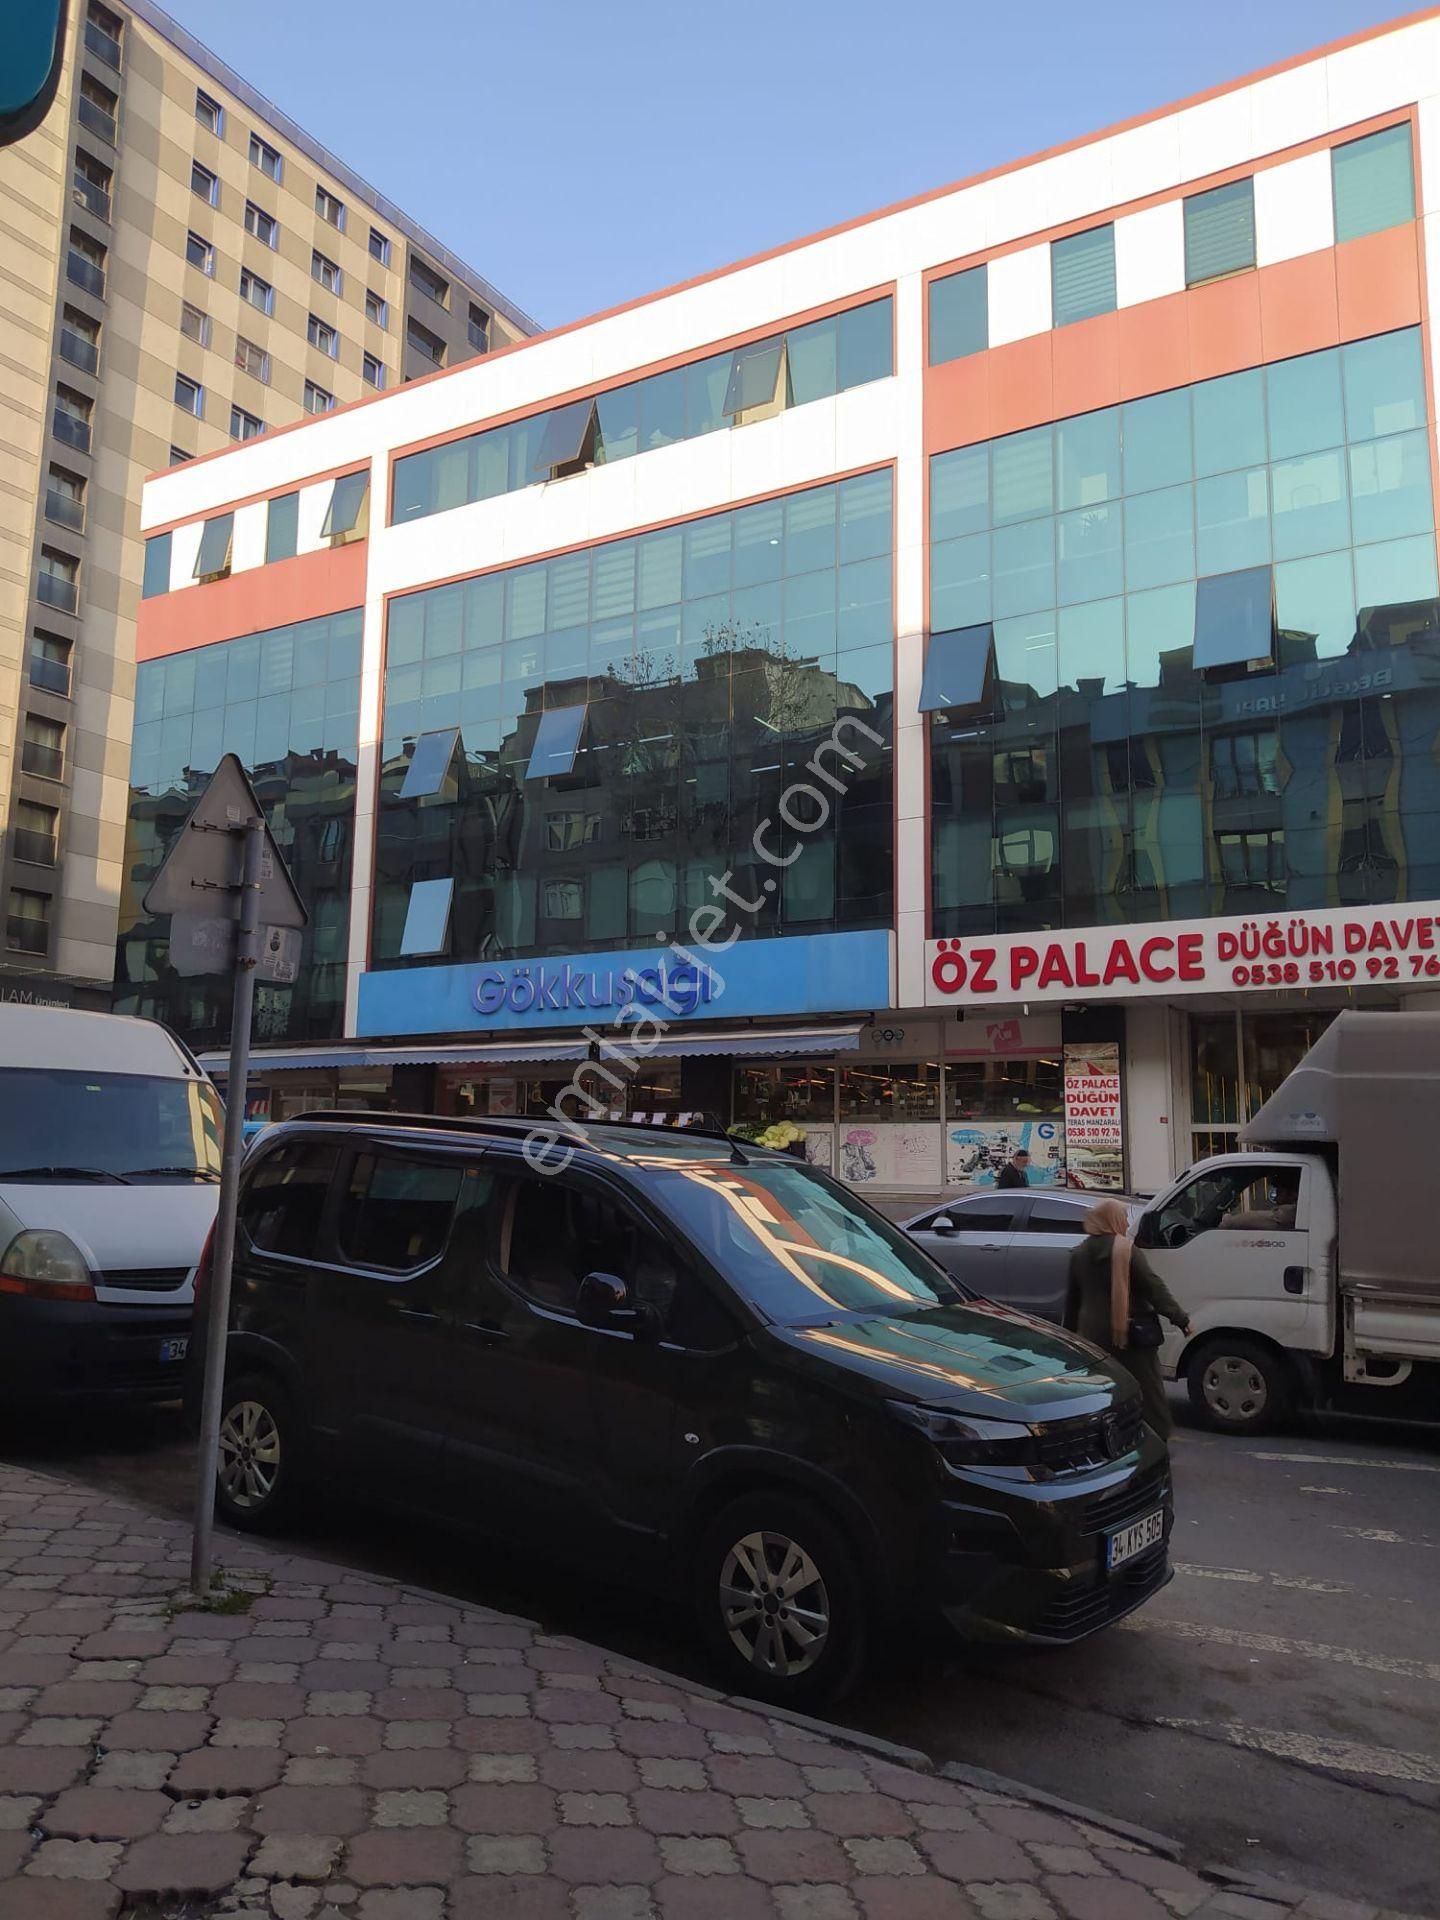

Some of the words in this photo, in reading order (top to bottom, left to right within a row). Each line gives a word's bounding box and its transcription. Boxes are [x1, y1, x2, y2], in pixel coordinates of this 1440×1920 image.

[1217, 918, 1333, 961] DÜĞÜN
[932, 939, 997, 993] ÖZ
[1010, 933, 1205, 990] PALACE
[1232, 962, 1299, 986] 0538
[1309, 959, 1356, 982] 510
[1366, 957, 1399, 979] 92
[1409, 954, 1440, 977] 76
[1066, 1077, 1079, 1089] ÖZ
[1081, 1079, 1118, 1089] PALACE
[1066, 1090, 1119, 1103] DÜĞÜN
[1069, 1106, 1116, 1117] DAVET
[1067, 1127, 1085, 1137] 0538
[1087, 1127, 1099, 1137] 510
[1101, 1127, 1110, 1137] 92
[1112, 1127, 1120, 1137] 76
[170, 1342, 185, 1359] 34
[1112, 1534, 1124, 1562] 34
[1127, 1522, 1144, 1555] KYS
[1146, 1512, 1161, 1543] 505
